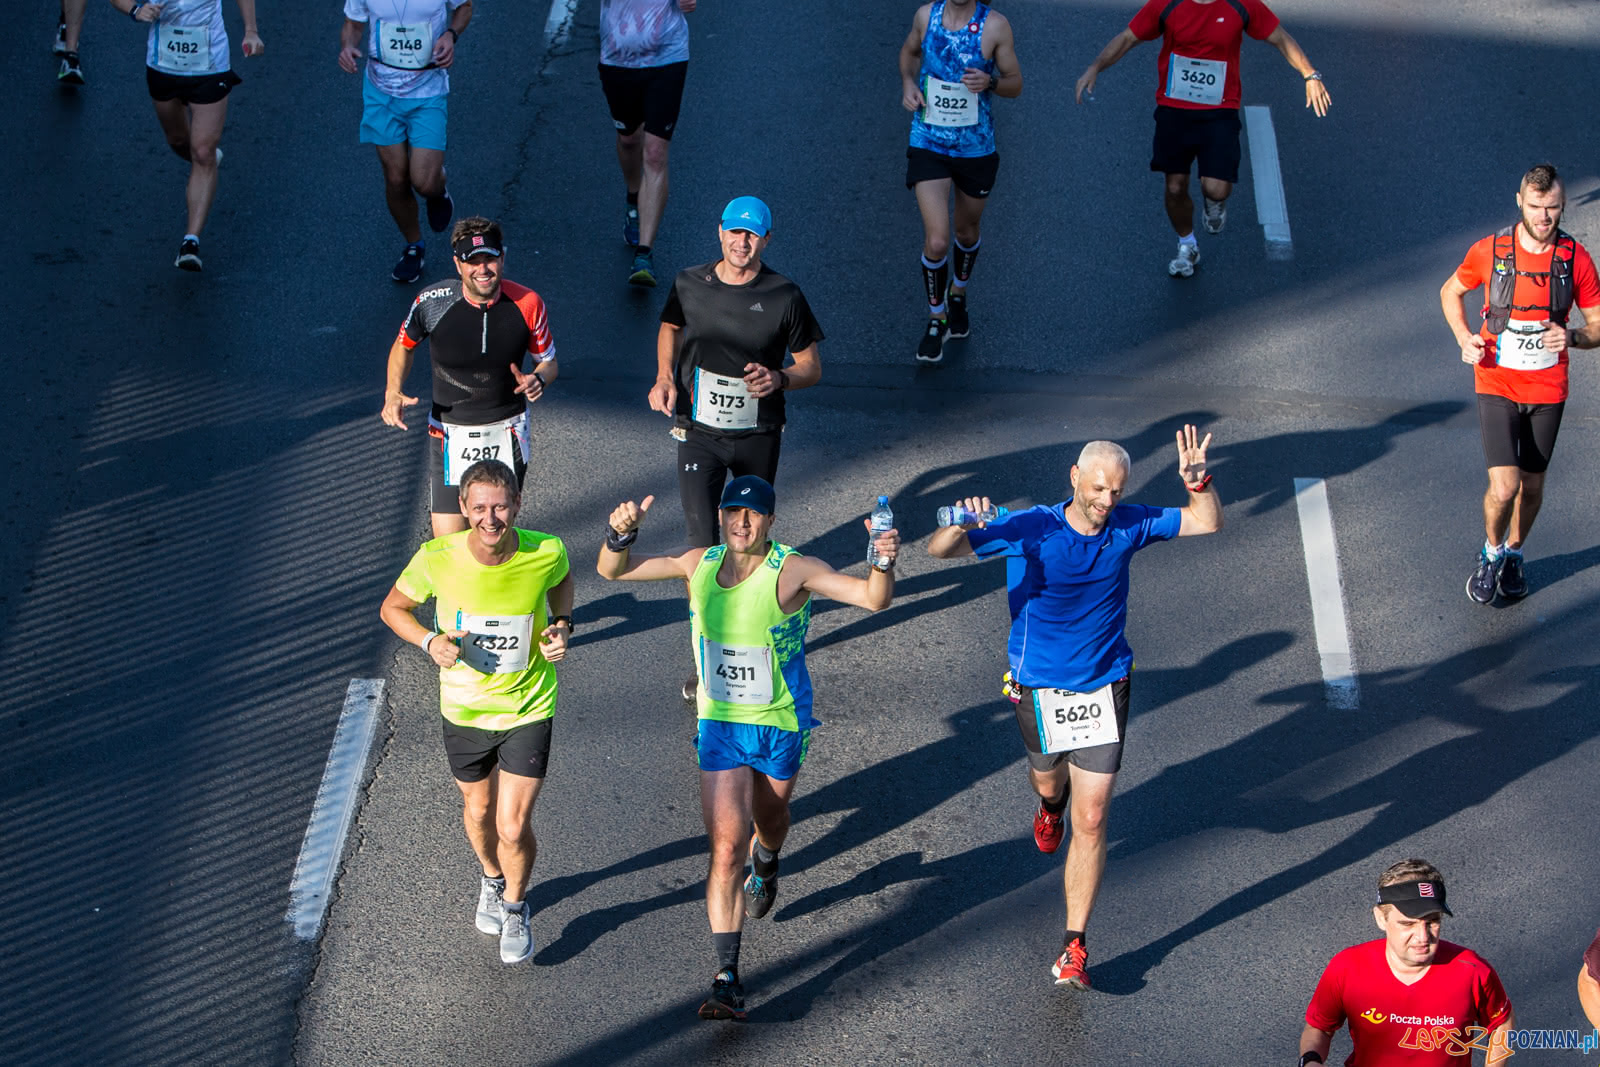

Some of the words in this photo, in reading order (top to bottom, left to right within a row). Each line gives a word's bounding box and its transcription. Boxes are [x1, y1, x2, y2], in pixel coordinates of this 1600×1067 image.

[167, 40, 198, 54] 4182
[389, 39, 422, 50] 2148
[1181, 69, 1216, 86] 3620
[934, 95, 968, 109] 2822
[709, 391, 745, 409] 3173
[461, 445, 500, 461] 4287
[472, 635, 519, 650] 4322
[716, 663, 755, 681] 4311
[1055, 702, 1102, 725] 5620
[1389, 1013, 1422, 1025] Poczta
[1423, 1015, 1455, 1026] Polska
